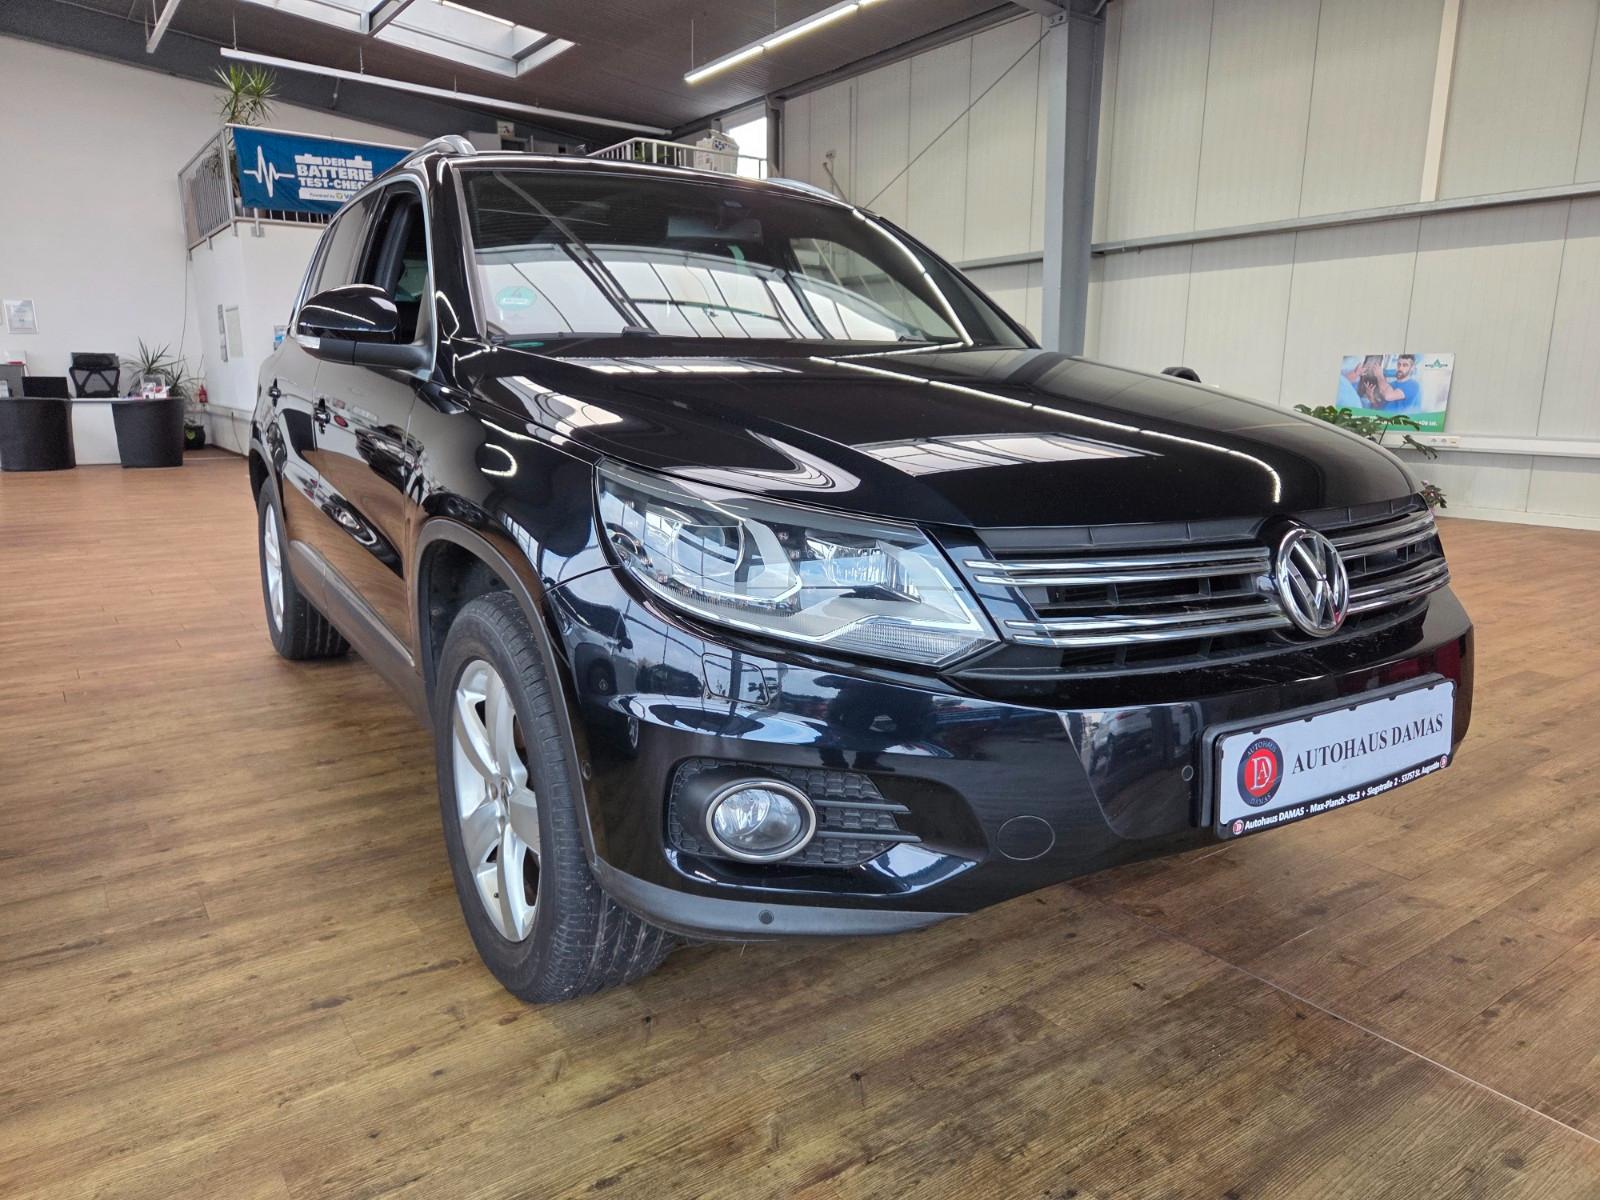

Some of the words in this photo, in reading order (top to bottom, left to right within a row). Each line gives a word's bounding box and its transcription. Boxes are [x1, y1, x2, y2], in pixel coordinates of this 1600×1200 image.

[323, 157, 346, 167] DER
[296, 164, 374, 181] BATTERIE
[298, 177, 370, 190] TEST-CHEC
[1247, 740, 1277, 756] AUTOHAUS
[1292, 729, 1388, 775] AUTOHAUS
[1391, 713, 1443, 746] DAMAS
[1245, 814, 1278, 831] Autohaus
[1278, 806, 1305, 821] DAMAS
[1393, 777, 1398, 787] 2
[1248, 792, 1272, 806] DAMAS
